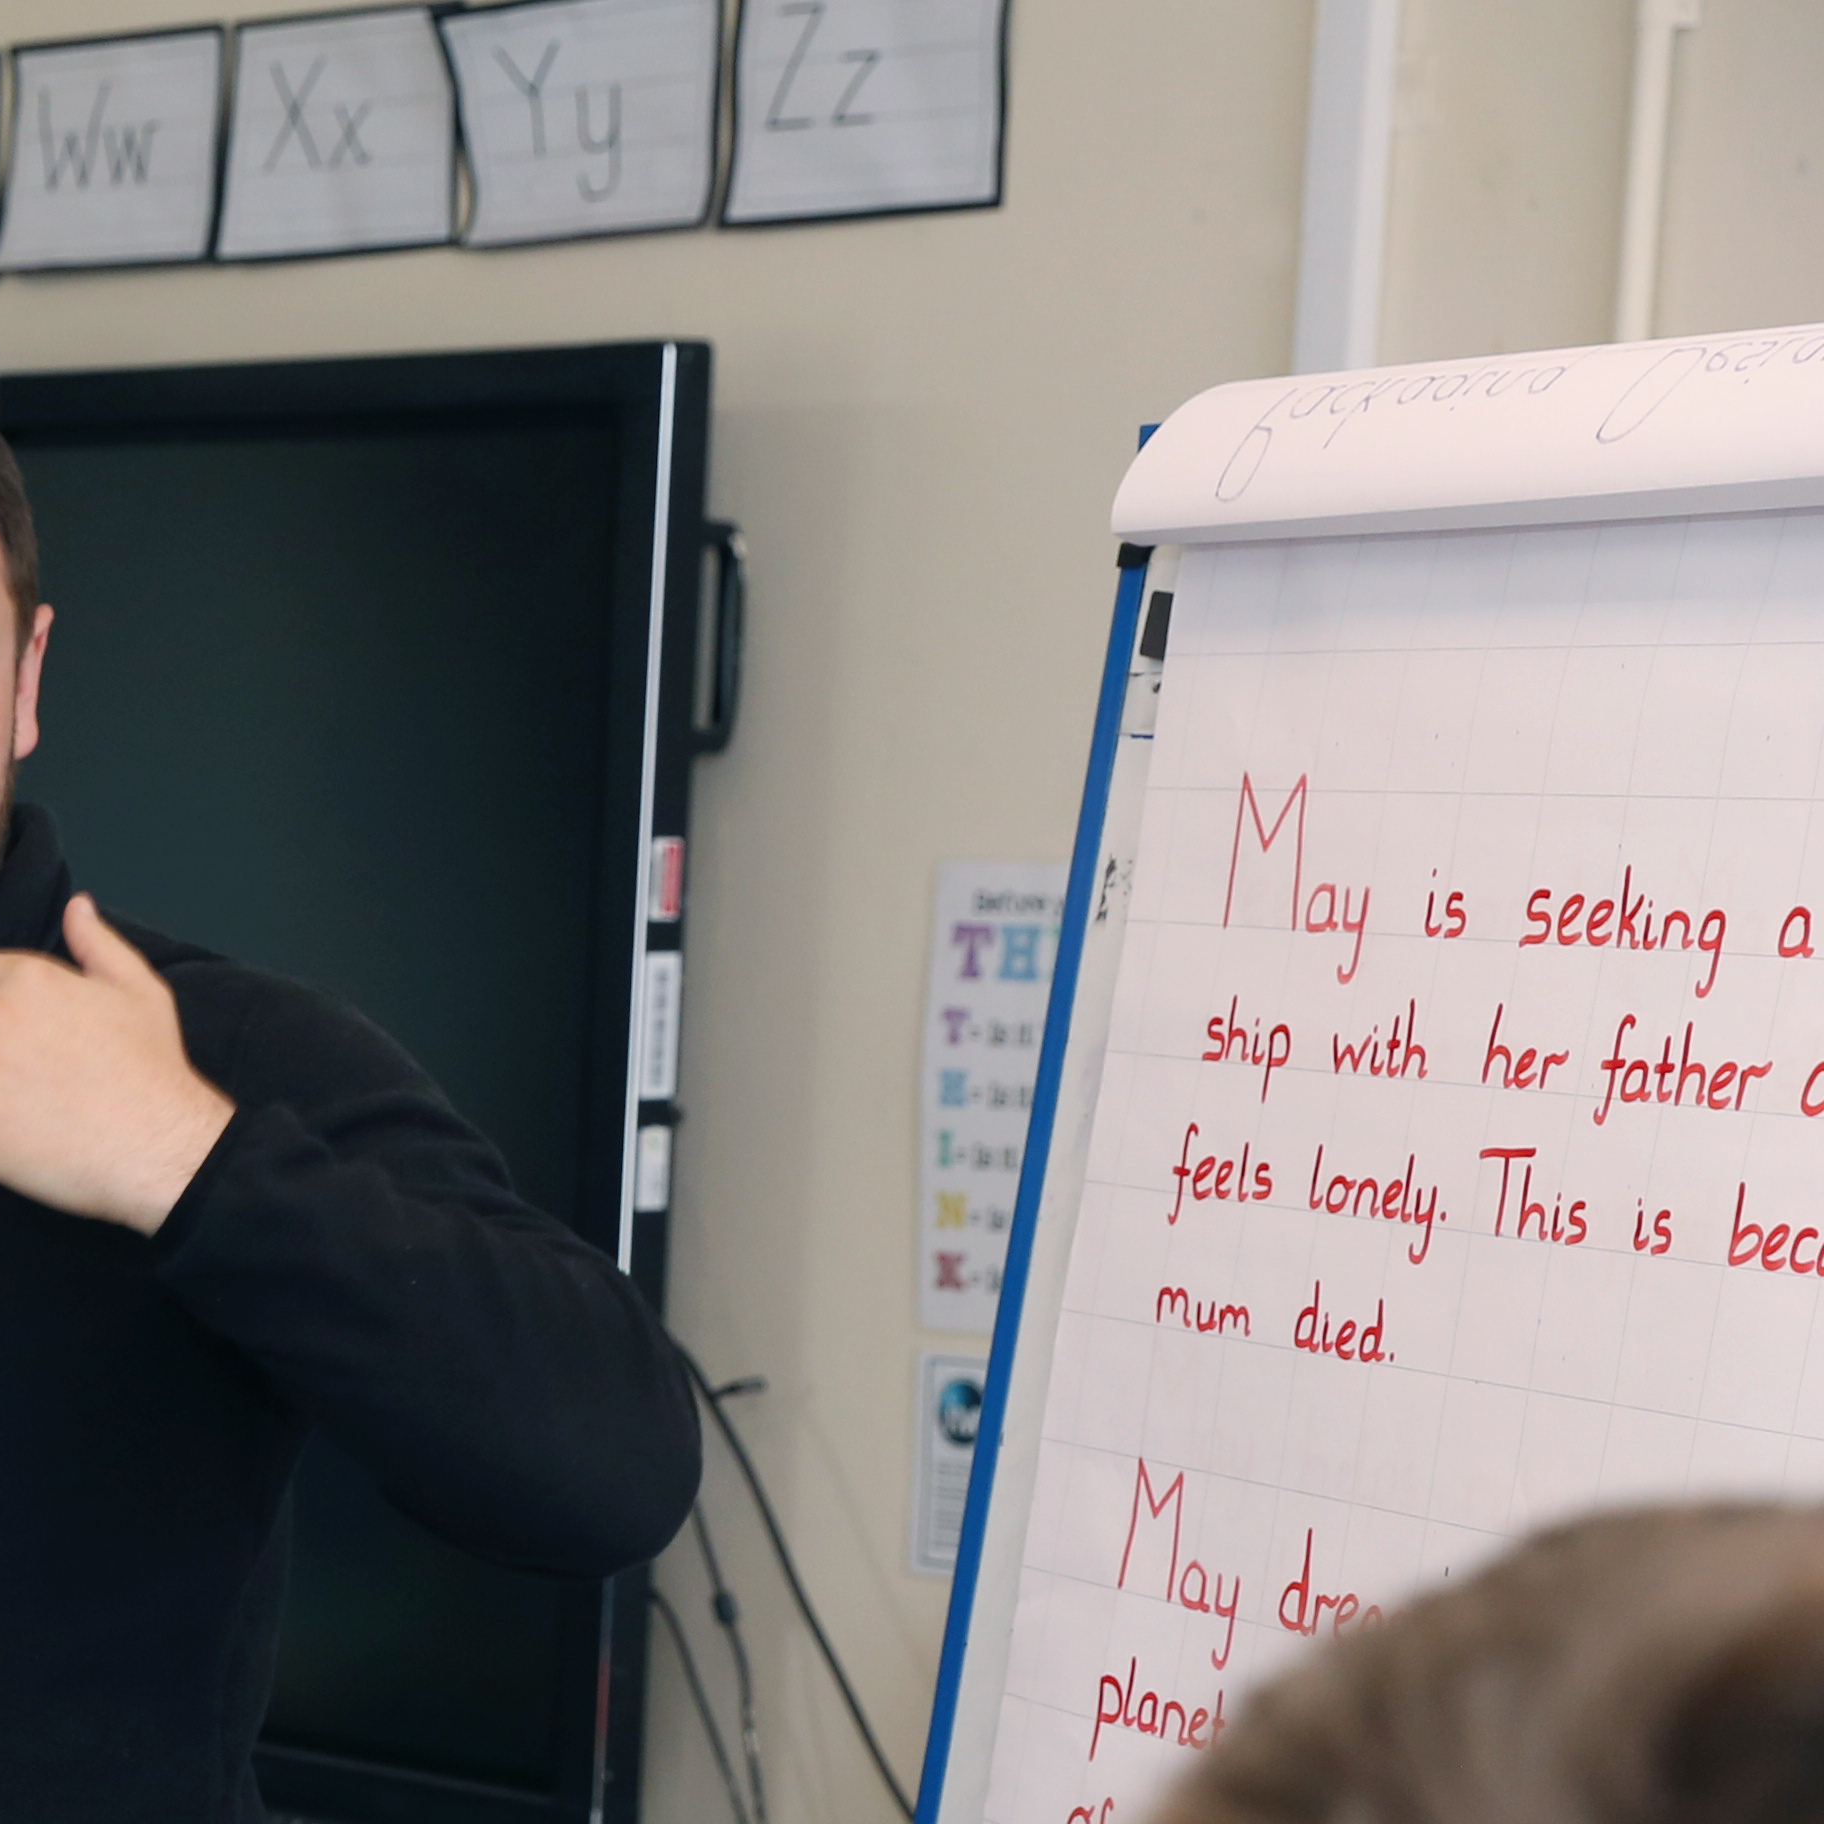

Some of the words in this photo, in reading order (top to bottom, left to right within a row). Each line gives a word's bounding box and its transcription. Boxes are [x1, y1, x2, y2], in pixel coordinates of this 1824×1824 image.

[261, 56, 372, 175] Xx
[491, 39, 625, 203] Yy
[763, 1, 882, 129] Zz
[36, 81, 156, 192] Ww
[1224, 774, 1370, 984] May
[1423, 869, 1468, 939] is
[1520, 866, 1726, 998] seeking
[1778, 906, 1814, 958] a
[1202, 997, 1291, 1100] ship
[1334, 1000, 1427, 1078] with
[1482, 1004, 1569, 1089] her
[1594, 1014, 1773, 1125] father
[1168, 1123, 1273, 1224] feels
[1310, 1146, 1447, 1264] lonely.
[1480, 1147, 1587, 1245] This
[1631, 1198, 1674, 1256] is
[1157, 1287, 1250, 1336] mum
[1295, 1282, 1395, 1362] died.
[1118, 1460, 1240, 1673] May
[1277, 1528, 1392, 1640] drea
